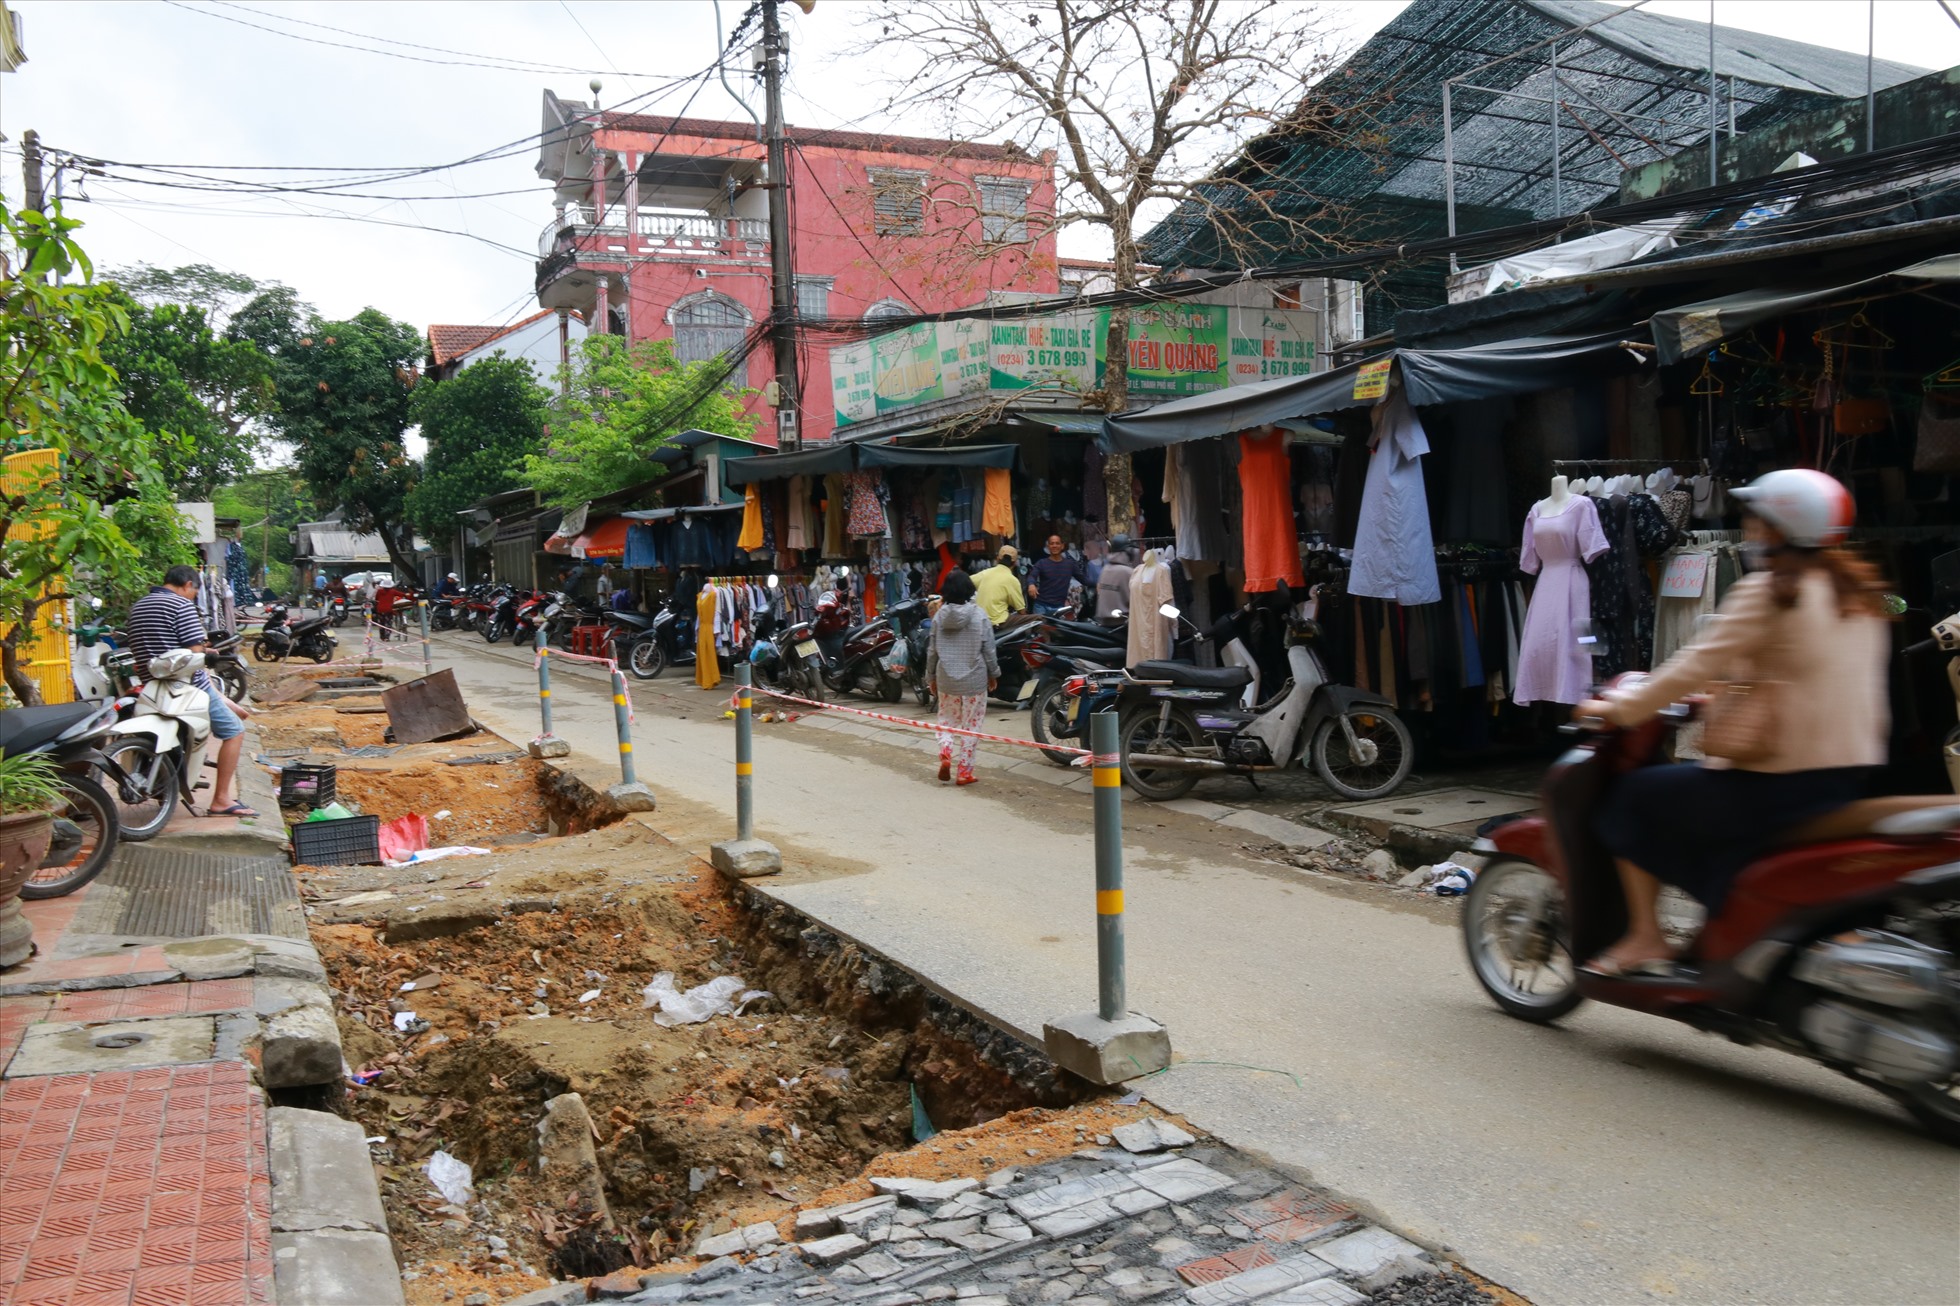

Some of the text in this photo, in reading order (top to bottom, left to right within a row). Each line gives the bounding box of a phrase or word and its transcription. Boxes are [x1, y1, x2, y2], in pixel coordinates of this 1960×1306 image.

[1129, 309, 1161, 326] HOP
[991, 325, 1027, 346] XANHTAXI
[1029, 322, 1044, 346] HUẾ
[1050, 328, 1066, 348] TAXI
[1164, 333, 1218, 375] QUẢNG
[1263, 335, 1275, 358] HUẾ
[1281, 340, 1294, 358] TAXI
[997, 350, 1087, 367] (0234) 3 678 999
[1236, 360, 1310, 376] (0234) 3 678 999
[1670, 555, 1706, 571] HÀNG
